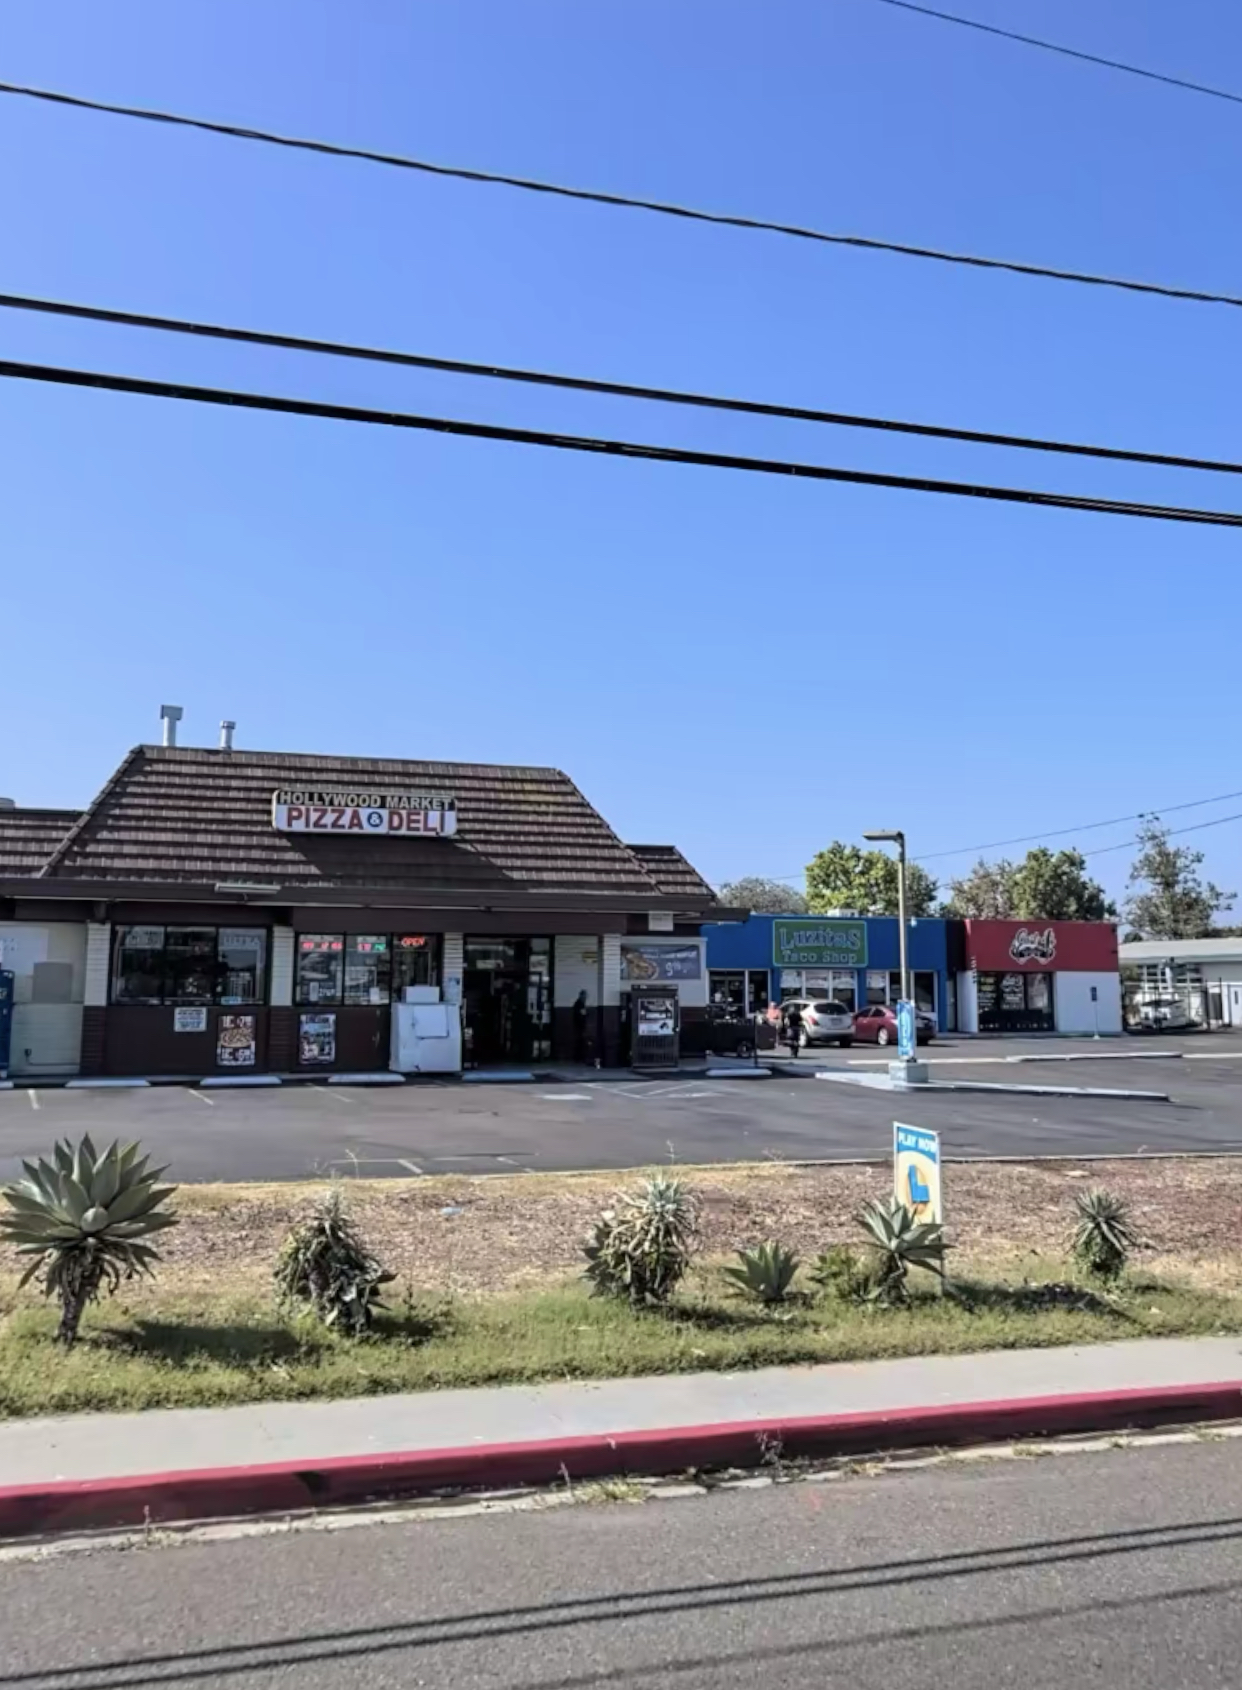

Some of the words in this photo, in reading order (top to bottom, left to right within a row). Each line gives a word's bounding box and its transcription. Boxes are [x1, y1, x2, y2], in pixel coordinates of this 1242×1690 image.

[279, 792, 380, 808] HOLLYWOOD
[386, 796, 451, 810] MARKET
[286, 807, 364, 830] PIZZA
[368, 811, 383, 827] &
[388, 810, 446, 833] DELI
[401, 936, 425, 947] OPEN
[782, 949, 818, 963] Taco
[822, 951, 857, 966] Shop
[899, 1131, 917, 1148] PLAY
[918, 1136, 937, 1154] NOW
